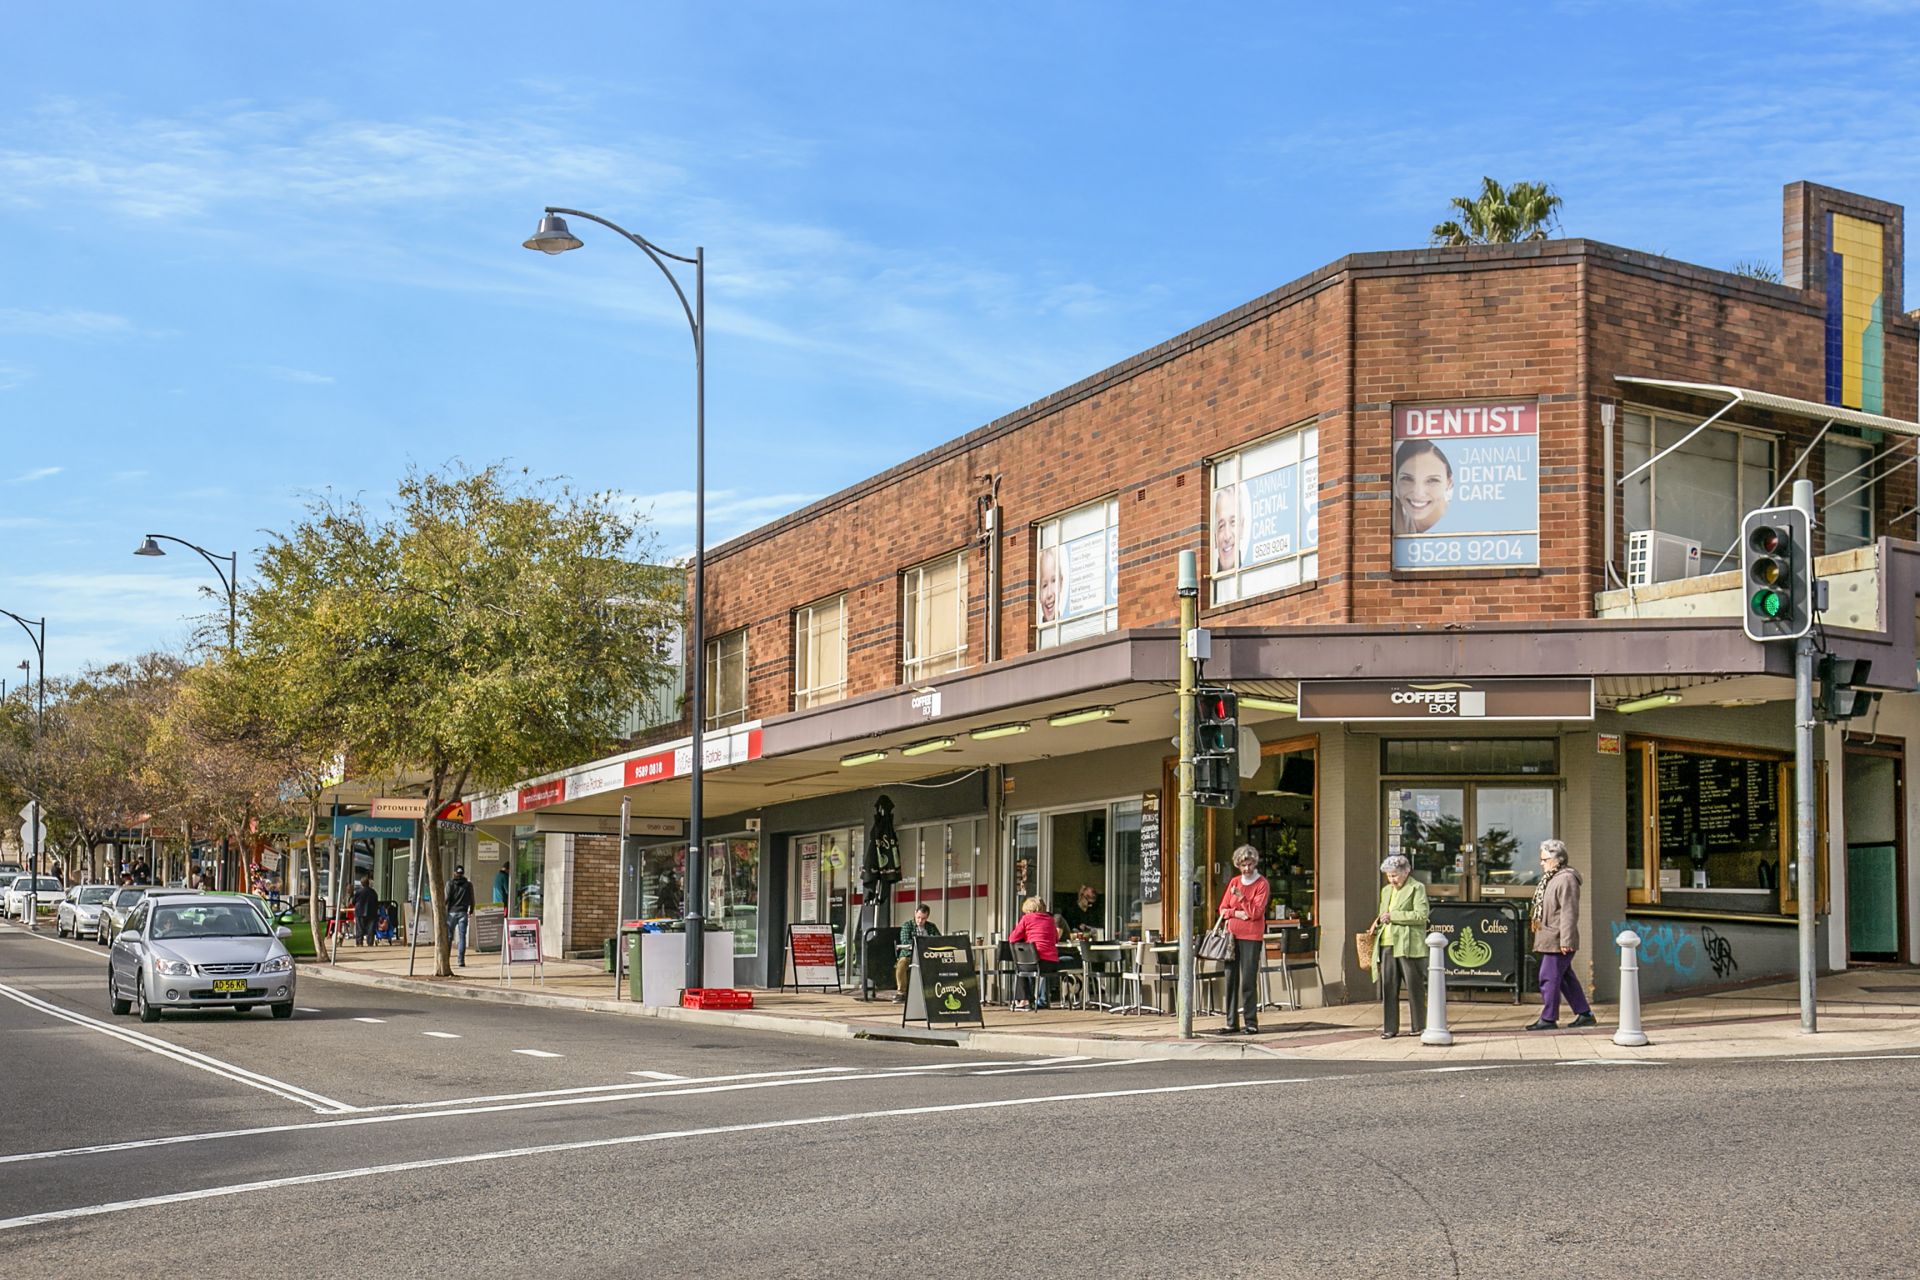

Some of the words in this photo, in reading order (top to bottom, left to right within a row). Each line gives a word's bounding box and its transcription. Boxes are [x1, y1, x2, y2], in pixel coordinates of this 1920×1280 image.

[1406, 406, 1525, 435] DENTIST
[1458, 446, 1531, 465] JANNALI
[1459, 465, 1527, 483] DENTAL
[1253, 470, 1291, 498] JANNALI
[1459, 484, 1506, 501] CARE
[1253, 493, 1288, 519] DENTAL
[1252, 517, 1278, 539] CARE
[1255, 541, 1271, 559] 9528
[1271, 538, 1288, 554] 9204
[1408, 541, 1461, 563] 9528
[1467, 539, 1523, 561] 9204
[1391, 691, 1457, 704] COFFEE
[1428, 703, 1457, 714] BOX
[635, 766, 648, 778] 9589
[649, 762, 663, 775] 0818
[376, 804, 426, 812] OPTOMETRIS
[364, 824, 402, 833] helloworld
[1481, 919, 1508, 934] Coffee
[923, 951, 954, 959] COFFEE
[225, 981, 235, 989] 56
[934, 981, 967, 998] Campos
